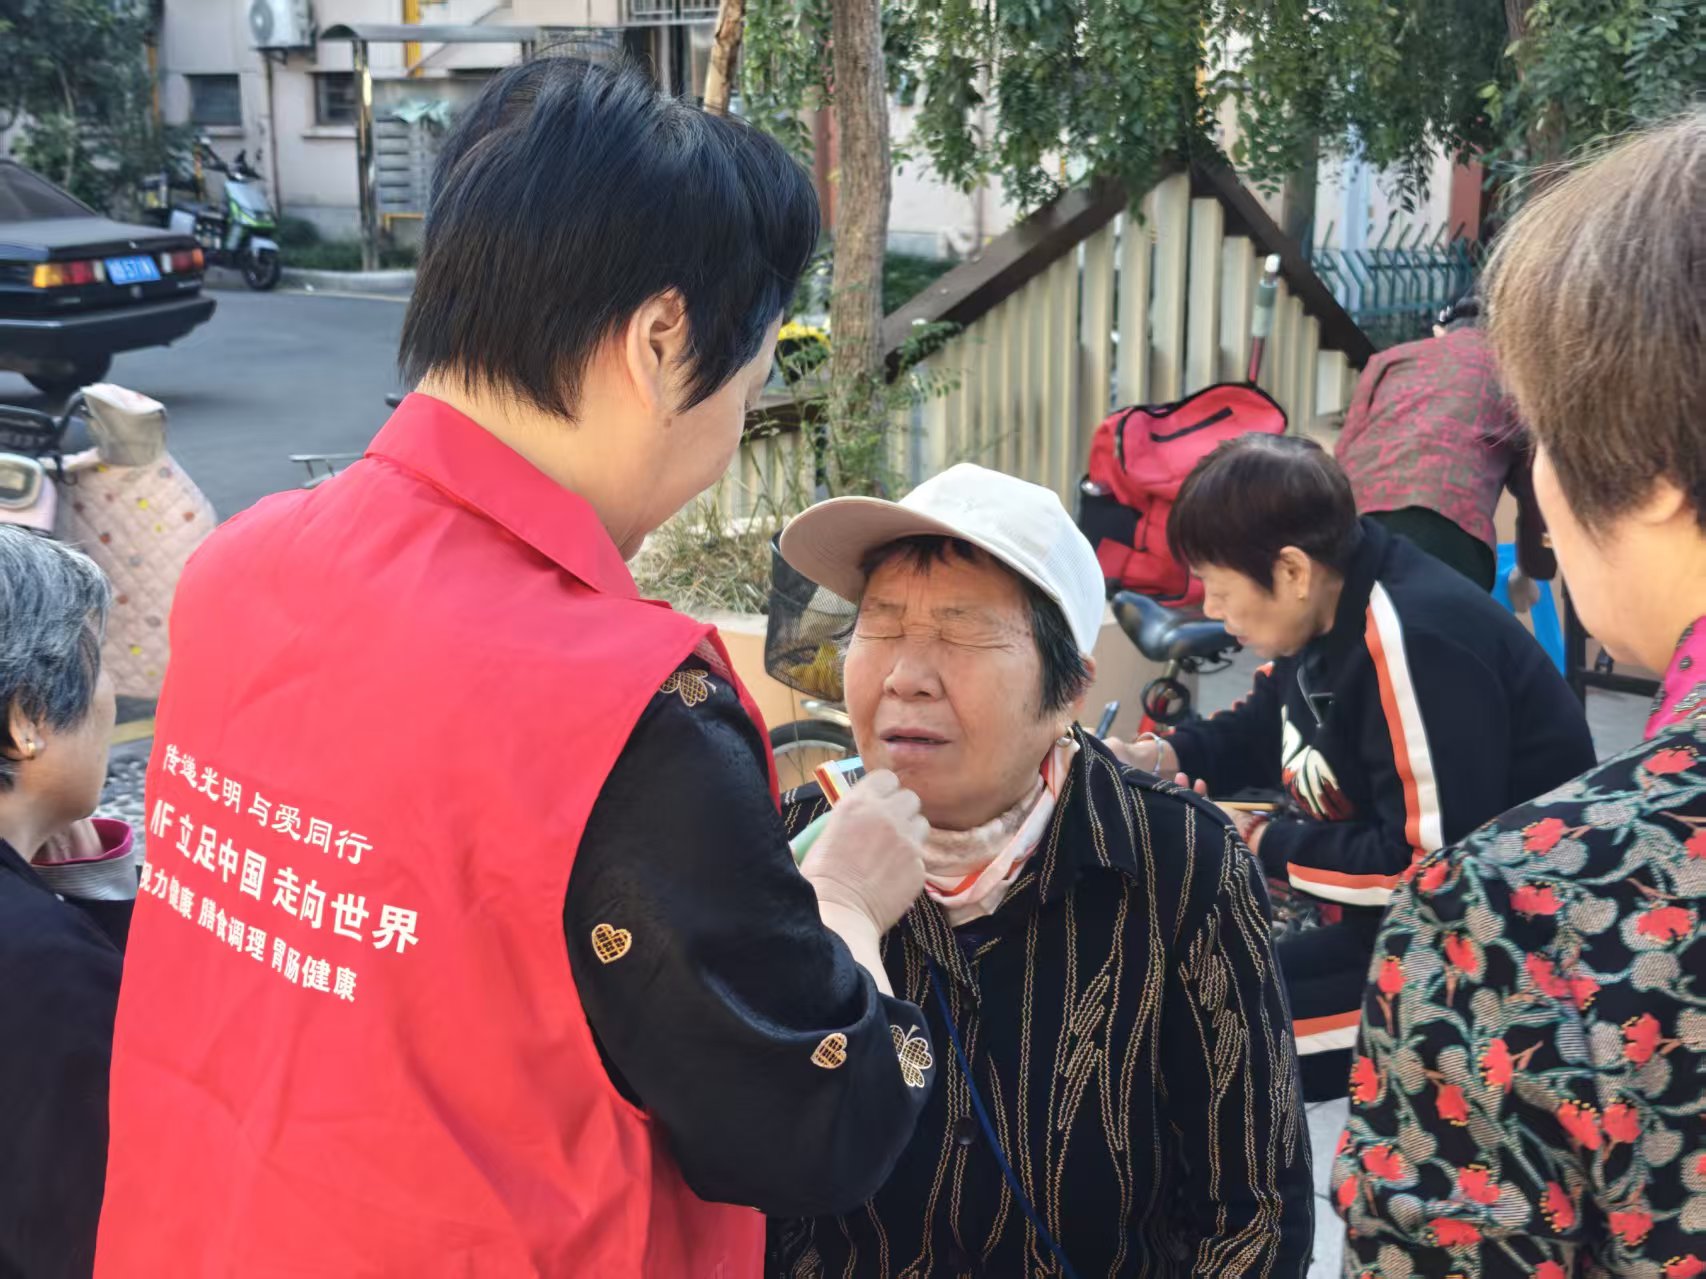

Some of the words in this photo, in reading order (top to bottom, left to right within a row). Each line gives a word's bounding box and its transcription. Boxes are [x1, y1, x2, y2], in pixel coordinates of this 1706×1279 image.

[163, 744, 242, 814] 传递光明
[247, 792, 373, 865] 与爱同行
[176, 814, 267, 901] 立足中国
[272, 867, 419, 954] 走向世界
[197, 896, 267, 962] 膳食调理
[271, 936, 357, 1003] 胃肠健康
